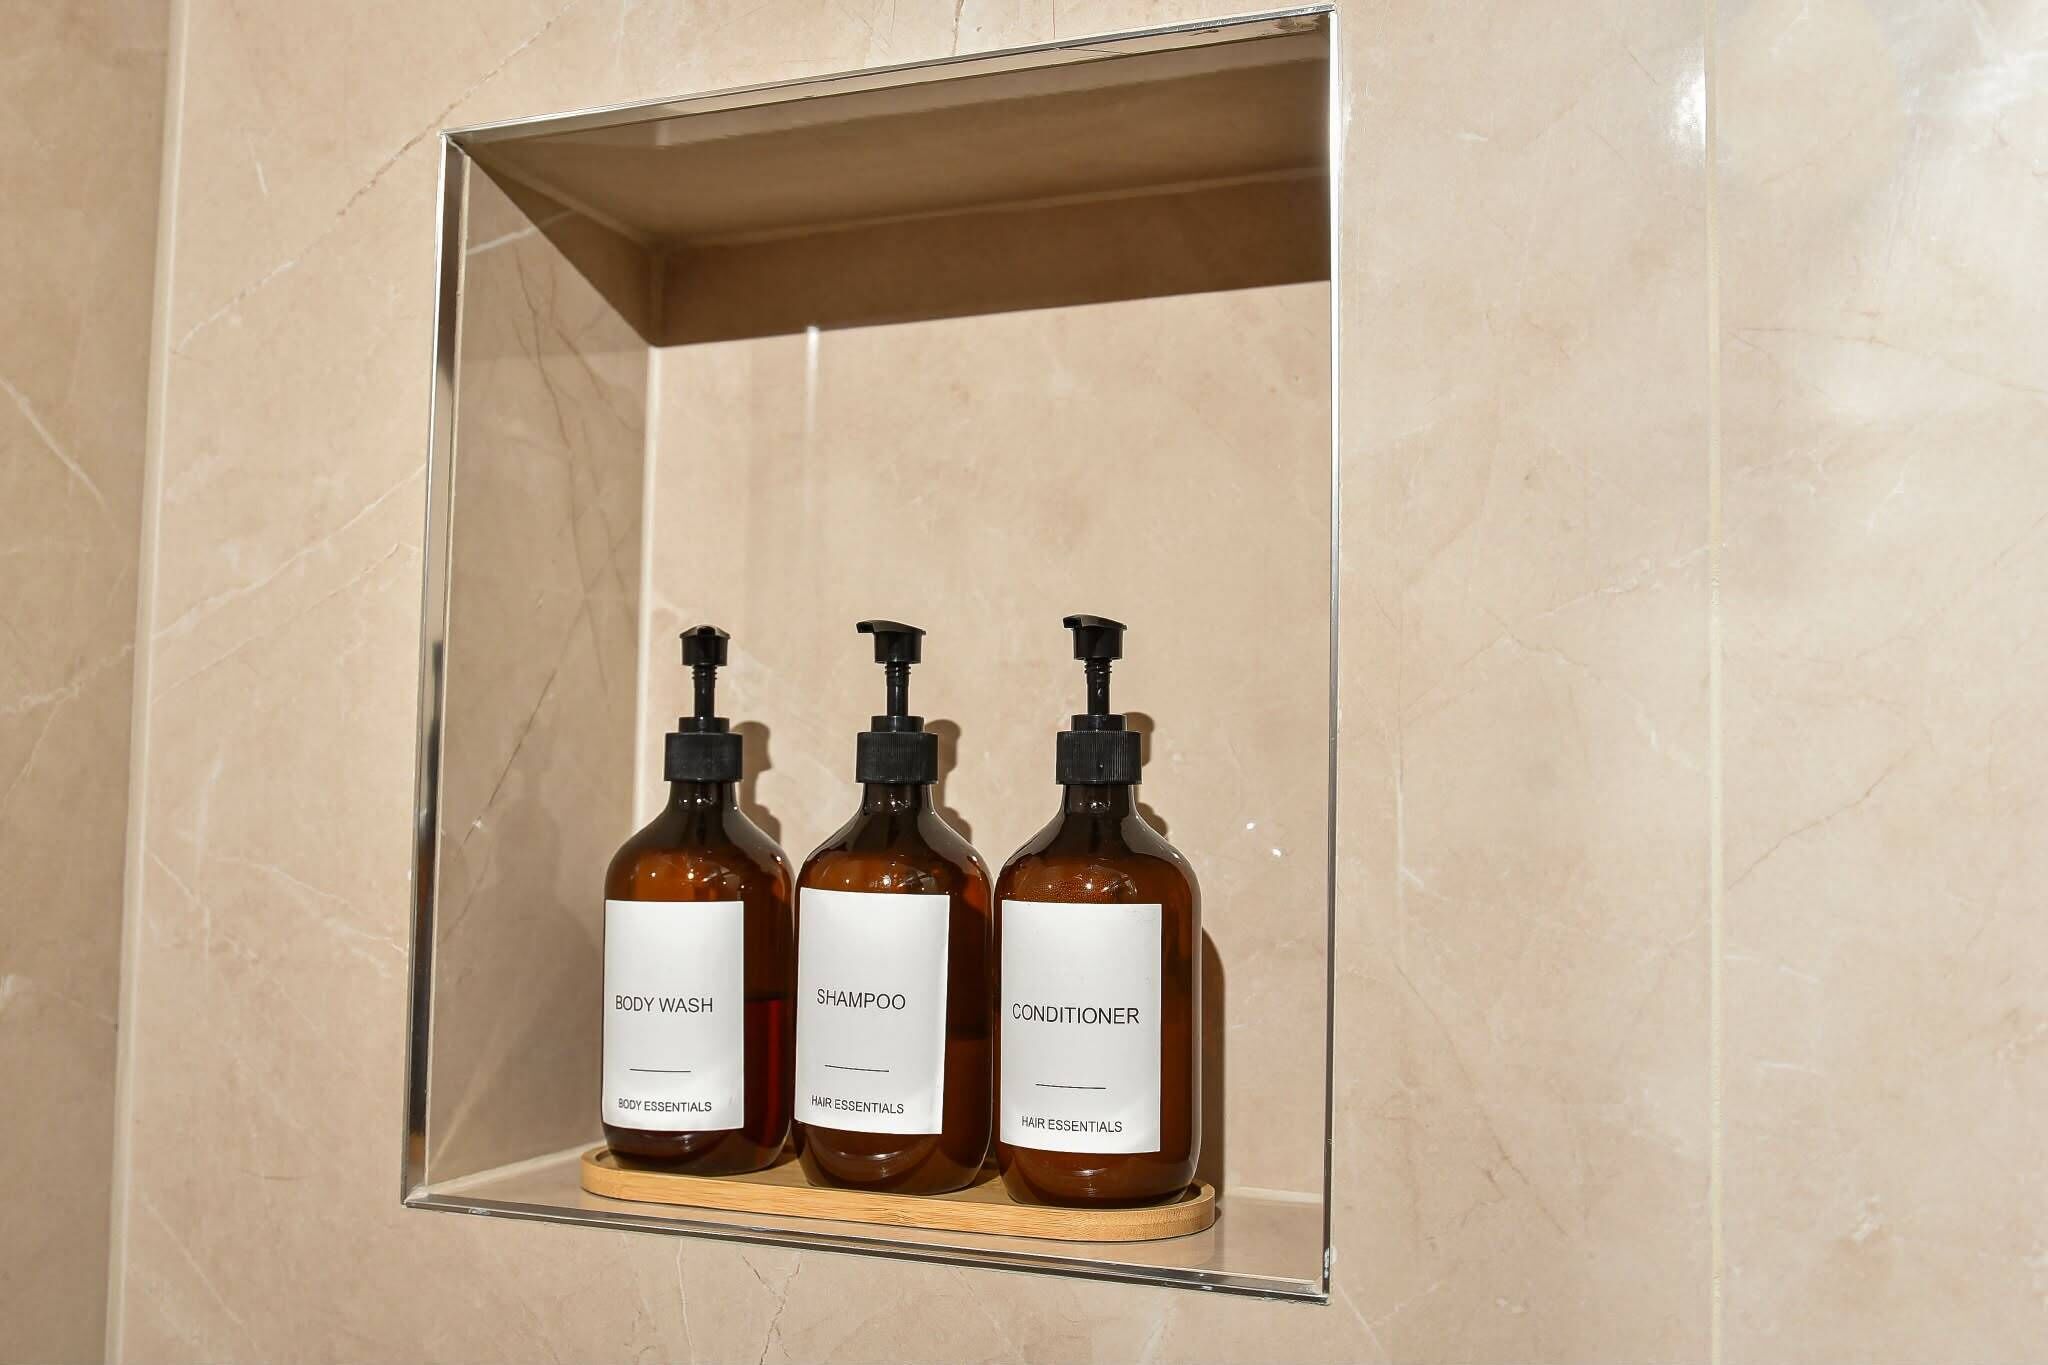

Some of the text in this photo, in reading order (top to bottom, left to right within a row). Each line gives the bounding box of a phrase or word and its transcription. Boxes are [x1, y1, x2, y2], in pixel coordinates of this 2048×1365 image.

[615, 994, 714, 1014] BODY WASH
[816, 988, 906, 1011] SHAMPOO
[1012, 1002, 1140, 1025] CONDITIONER
[618, 1097, 713, 1113] BODY ESSENTIALS
[811, 1094, 905, 1115] HAIR ESSENTIALS
[1021, 1115, 1123, 1133] HAIR ESSENTIALS
